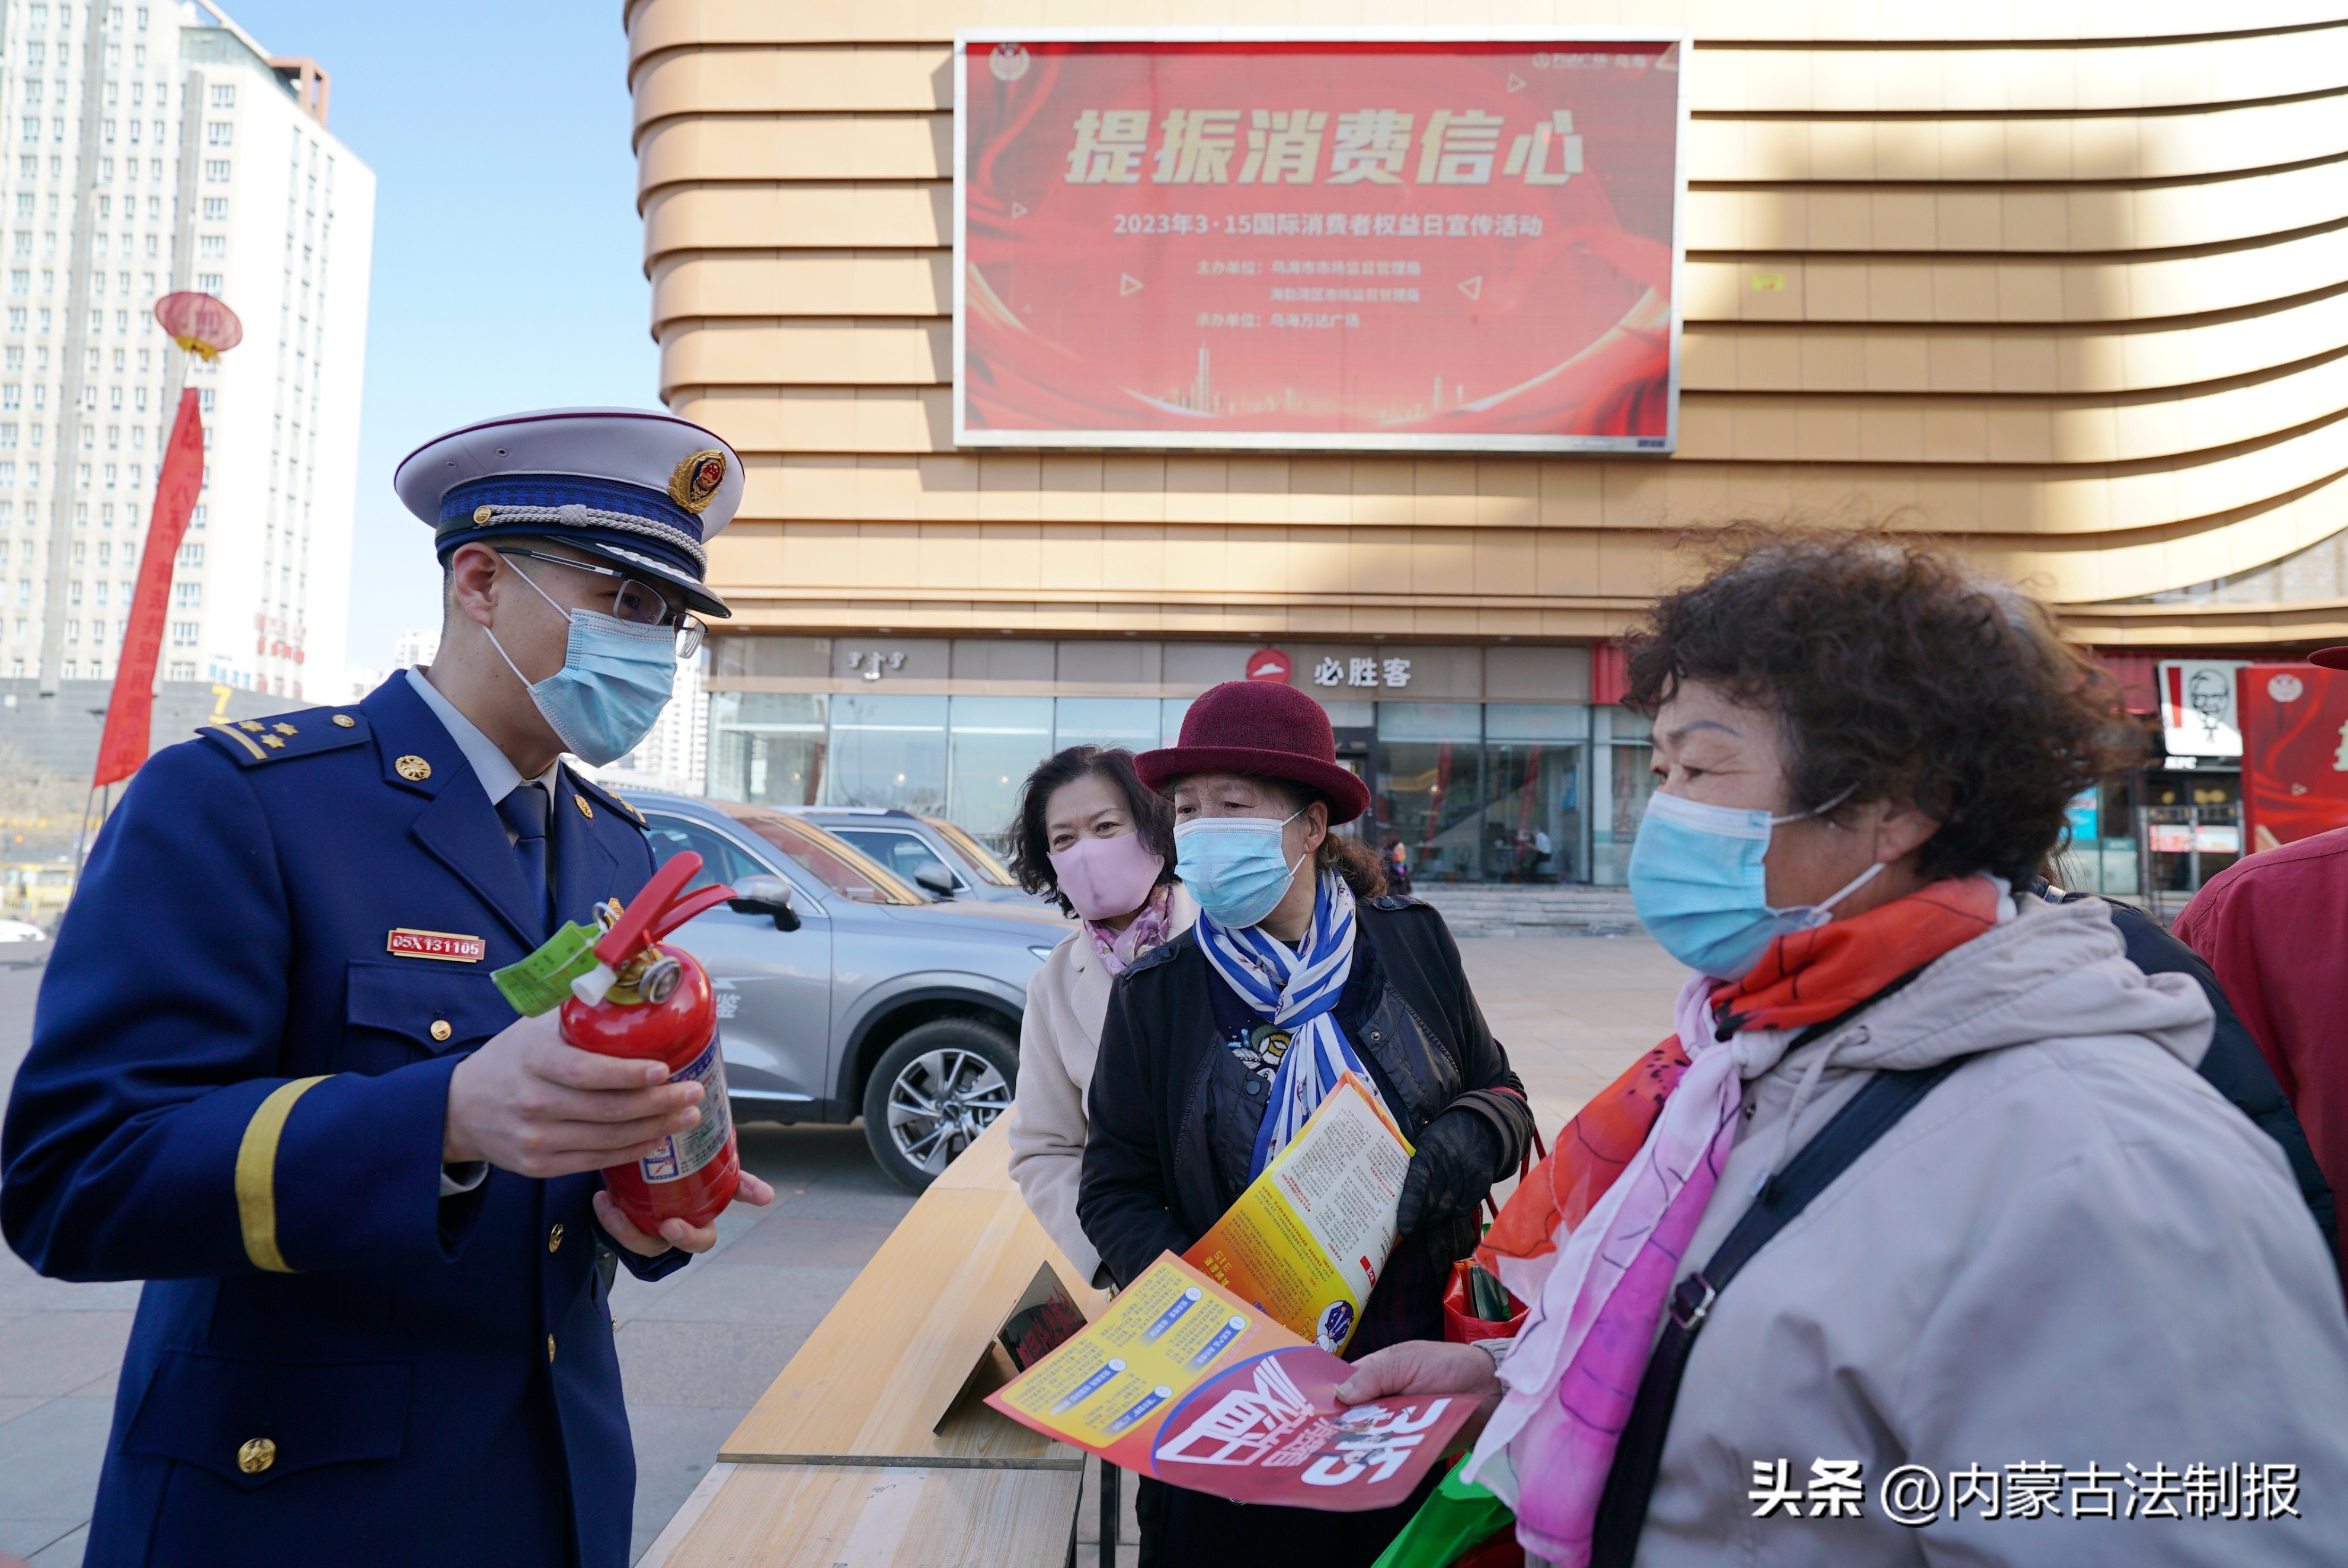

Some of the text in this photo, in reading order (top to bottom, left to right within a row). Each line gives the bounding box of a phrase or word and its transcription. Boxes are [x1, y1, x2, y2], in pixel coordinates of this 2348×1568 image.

[1064, 109, 1584, 184] 提振消费信心
[1113, 212, 1543, 238] 2023年3·15国际消费者权益日宣传活动
[1314, 656, 1412, 687] 必胜客
[393, 935, 479, 955] 05X131105
[1214, 1250, 1233, 1273] 315
[1156, 1355, 1316, 1466] 权益日
